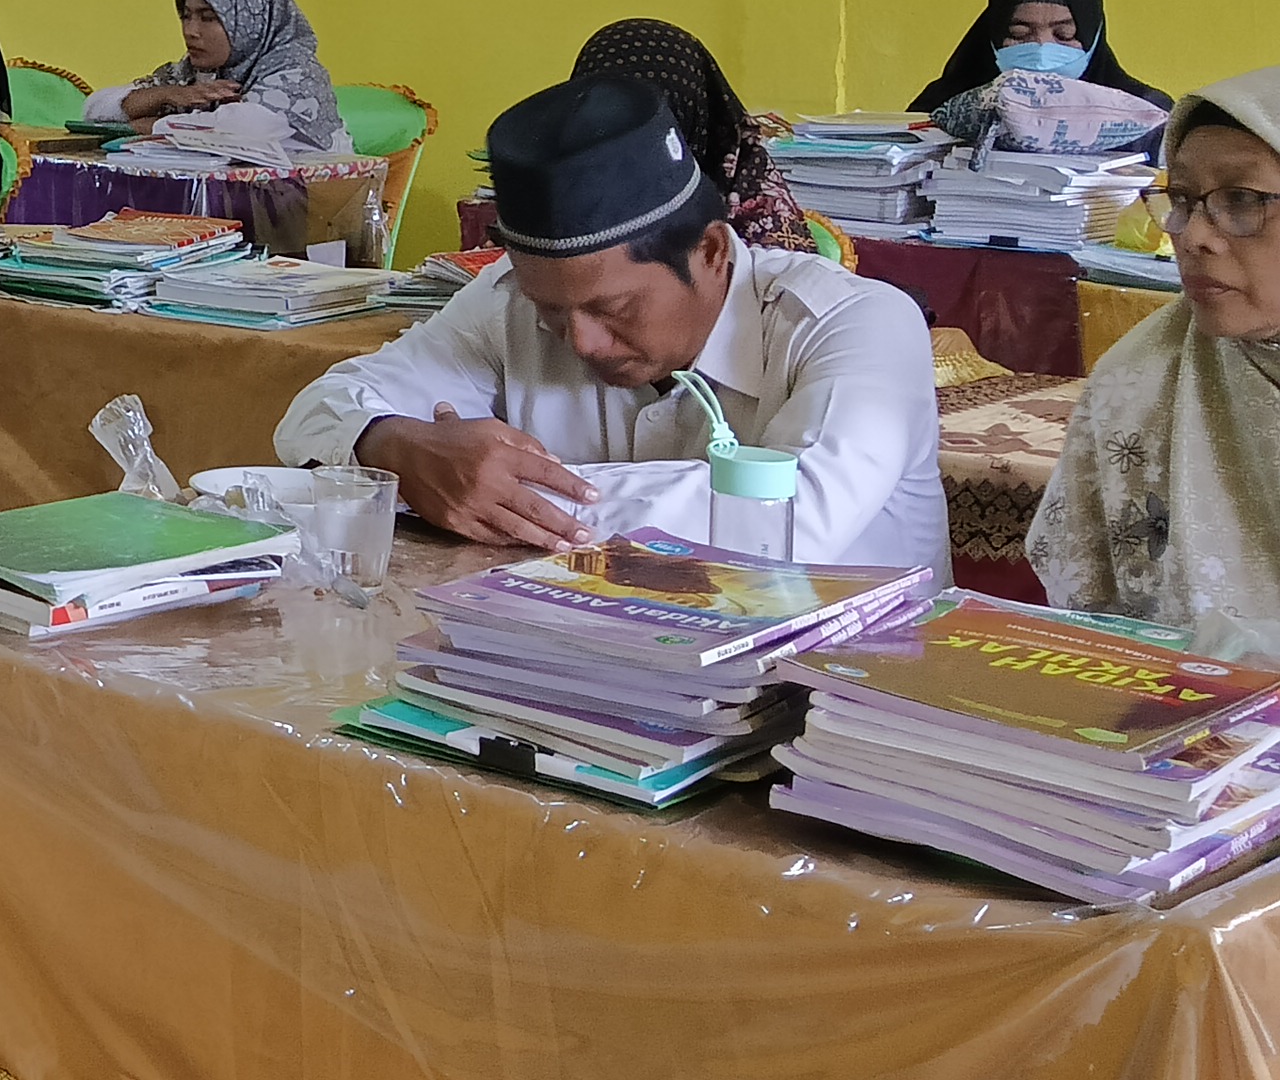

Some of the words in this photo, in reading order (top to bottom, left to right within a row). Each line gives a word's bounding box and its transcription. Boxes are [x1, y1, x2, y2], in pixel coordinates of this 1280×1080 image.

[498, 576, 620, 608] Akhlak
[622, 604, 748, 631] Akidah
[928, 634, 1172, 681] AKHLAK
[1095, 643, 1173, 664] MADRASAH
[988, 655, 1217, 703] AKIDAH
